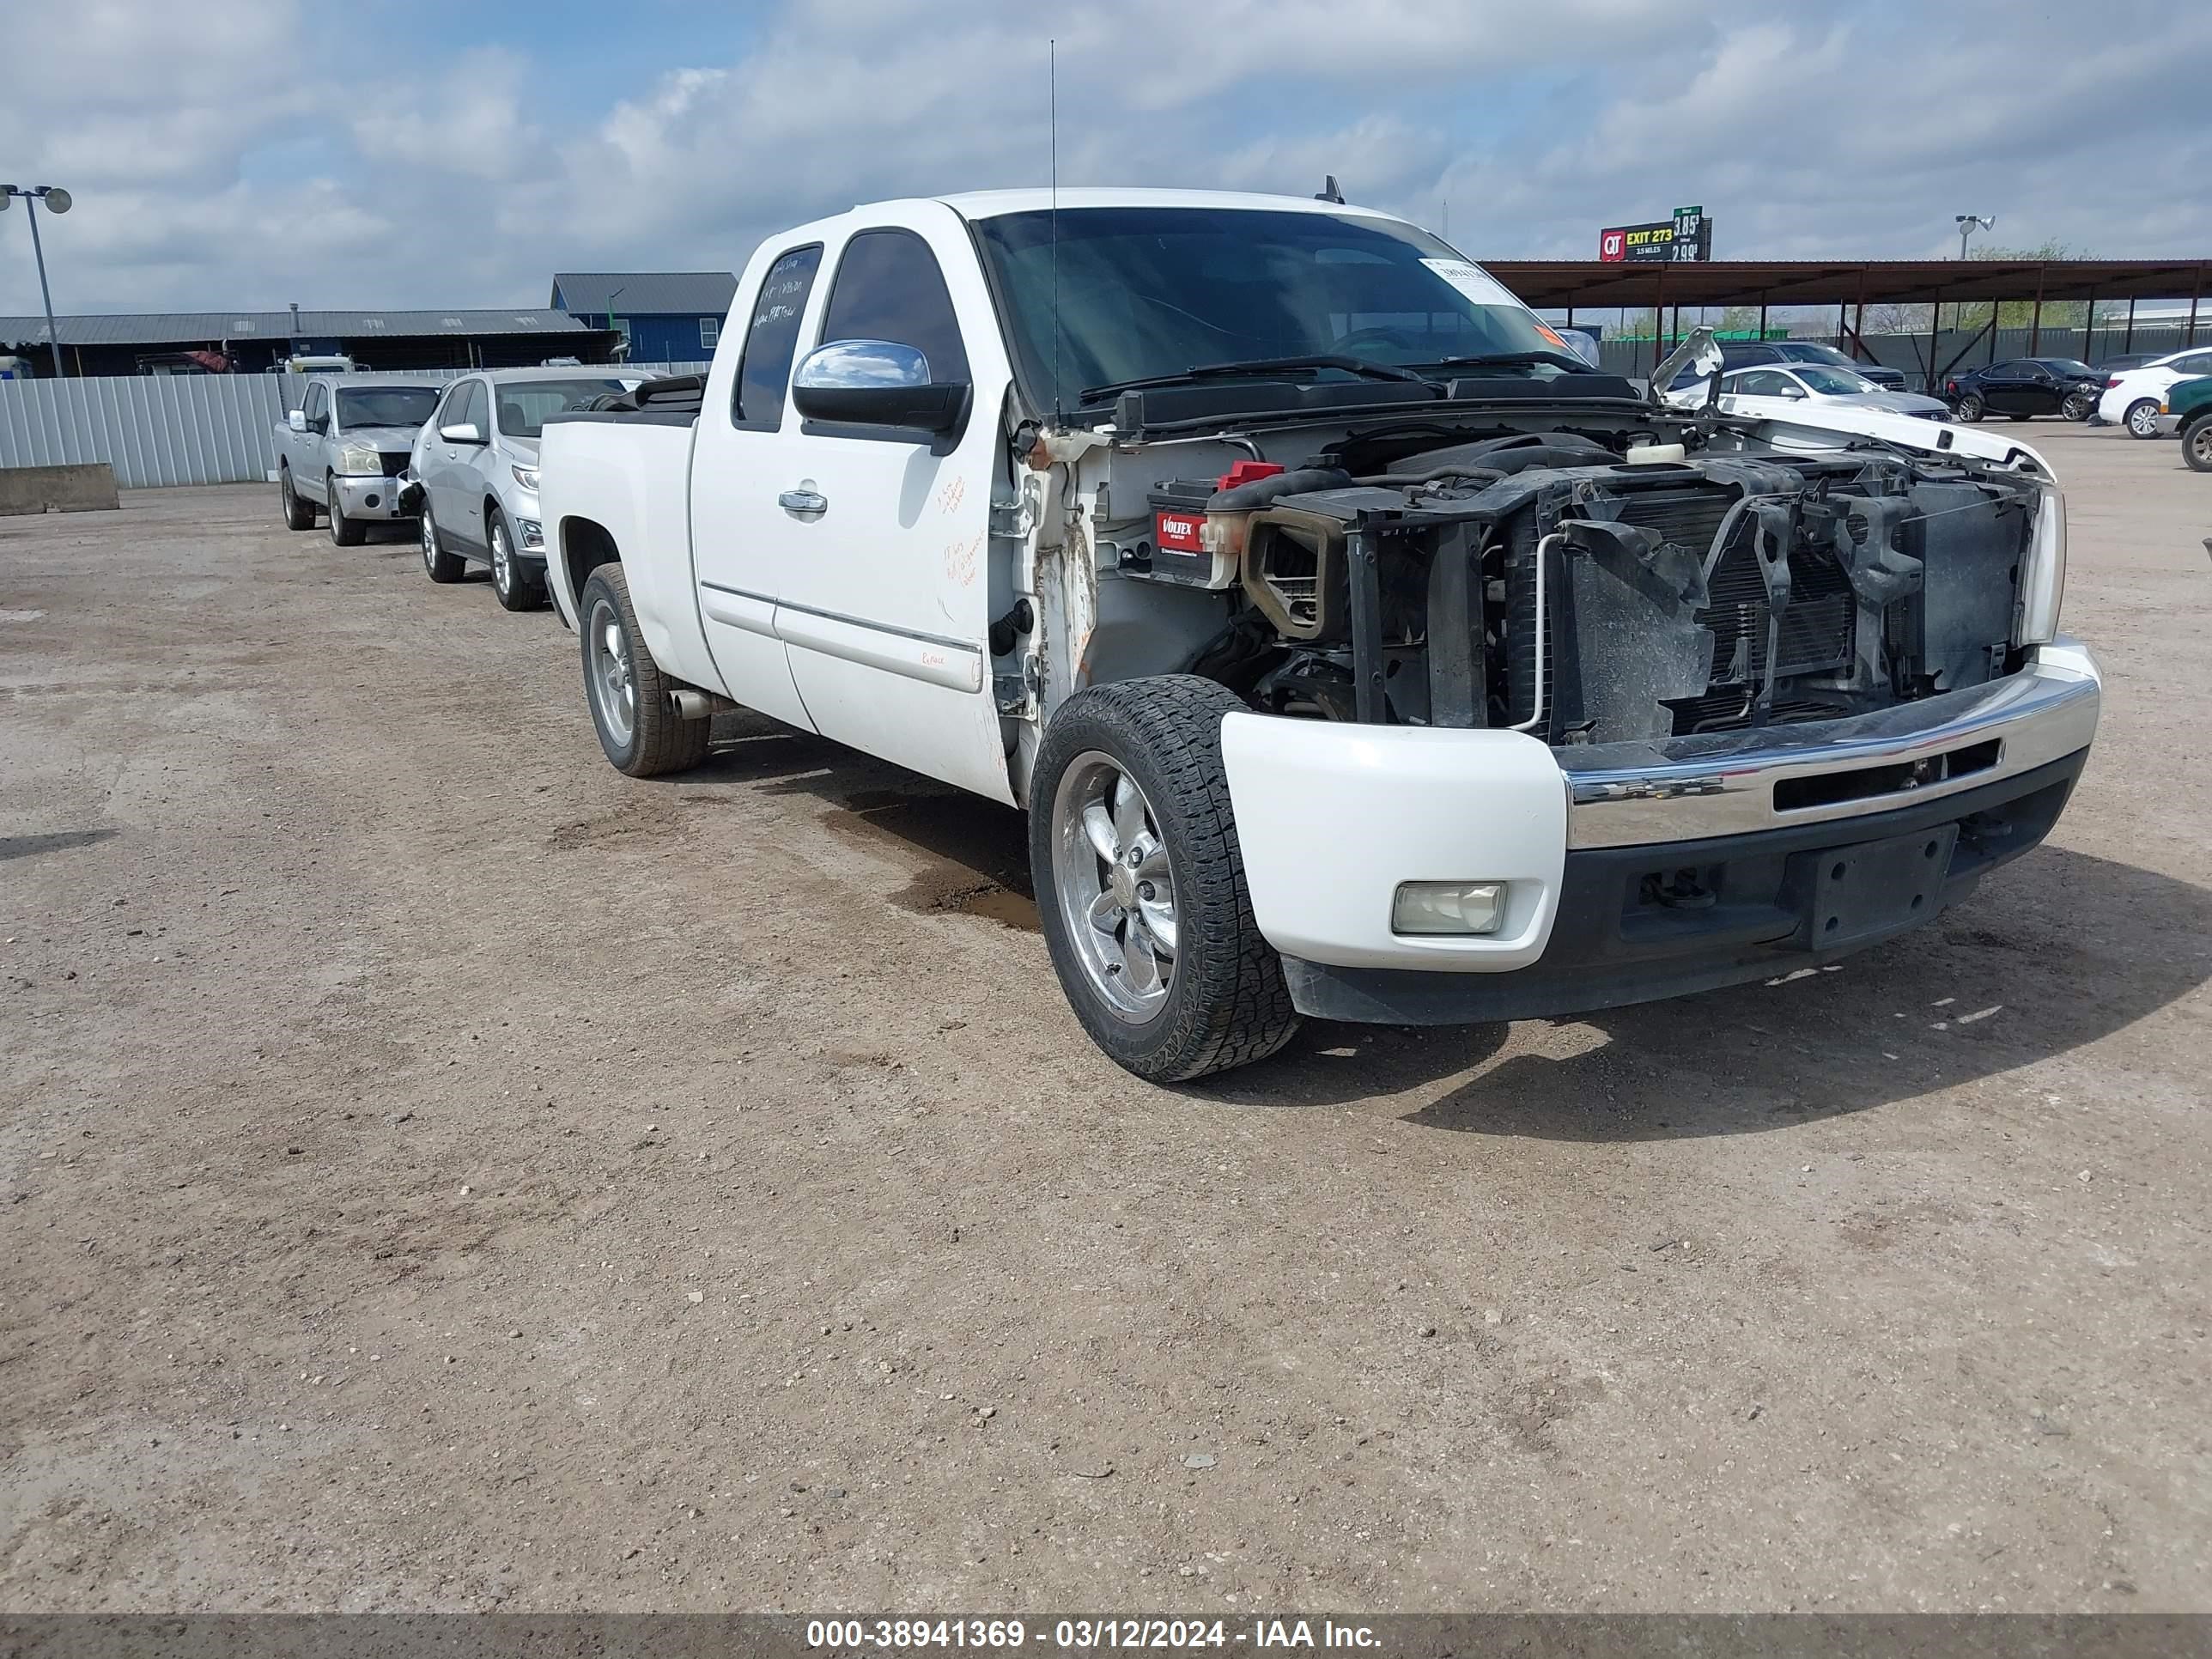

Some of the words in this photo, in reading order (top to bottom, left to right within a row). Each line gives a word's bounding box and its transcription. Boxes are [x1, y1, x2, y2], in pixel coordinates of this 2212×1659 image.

[1604, 235, 1621, 256] QT
[1626, 231, 1650, 245] EXIT
[1652, 228, 1673, 242] 273
[1645, 246, 1661, 254] MILES
[1163, 515, 1193, 536] VOLTEX
